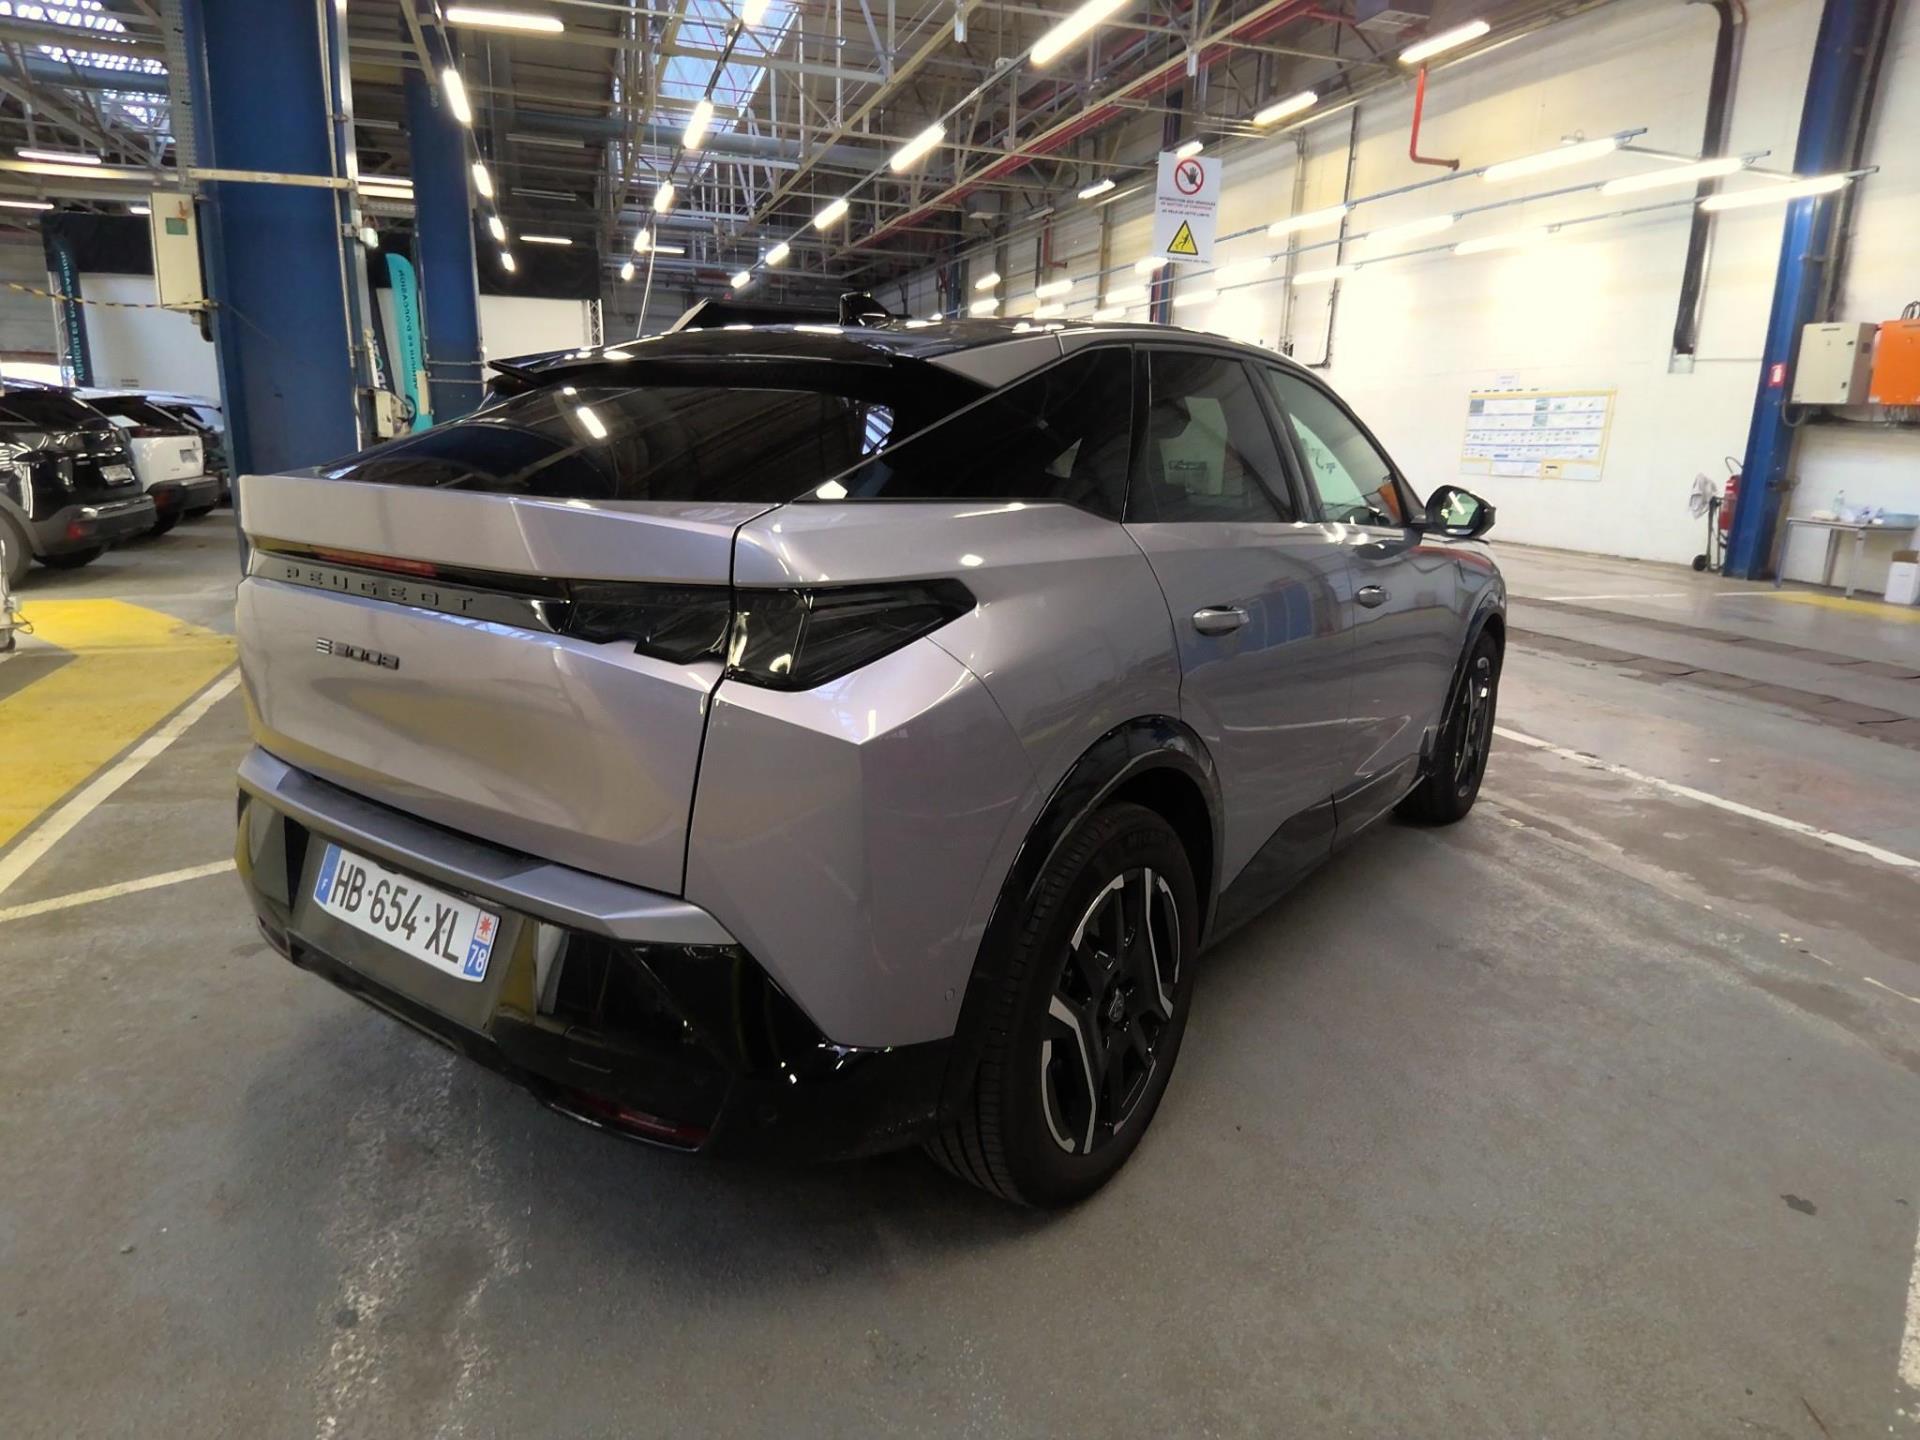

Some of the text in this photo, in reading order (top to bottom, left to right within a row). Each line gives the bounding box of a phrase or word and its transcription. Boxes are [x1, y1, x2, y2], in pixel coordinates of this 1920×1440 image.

[286, 567, 474, 611] PEUGEOT
[320, 878, 329, 890] F
[466, 944, 488, 973] 78
